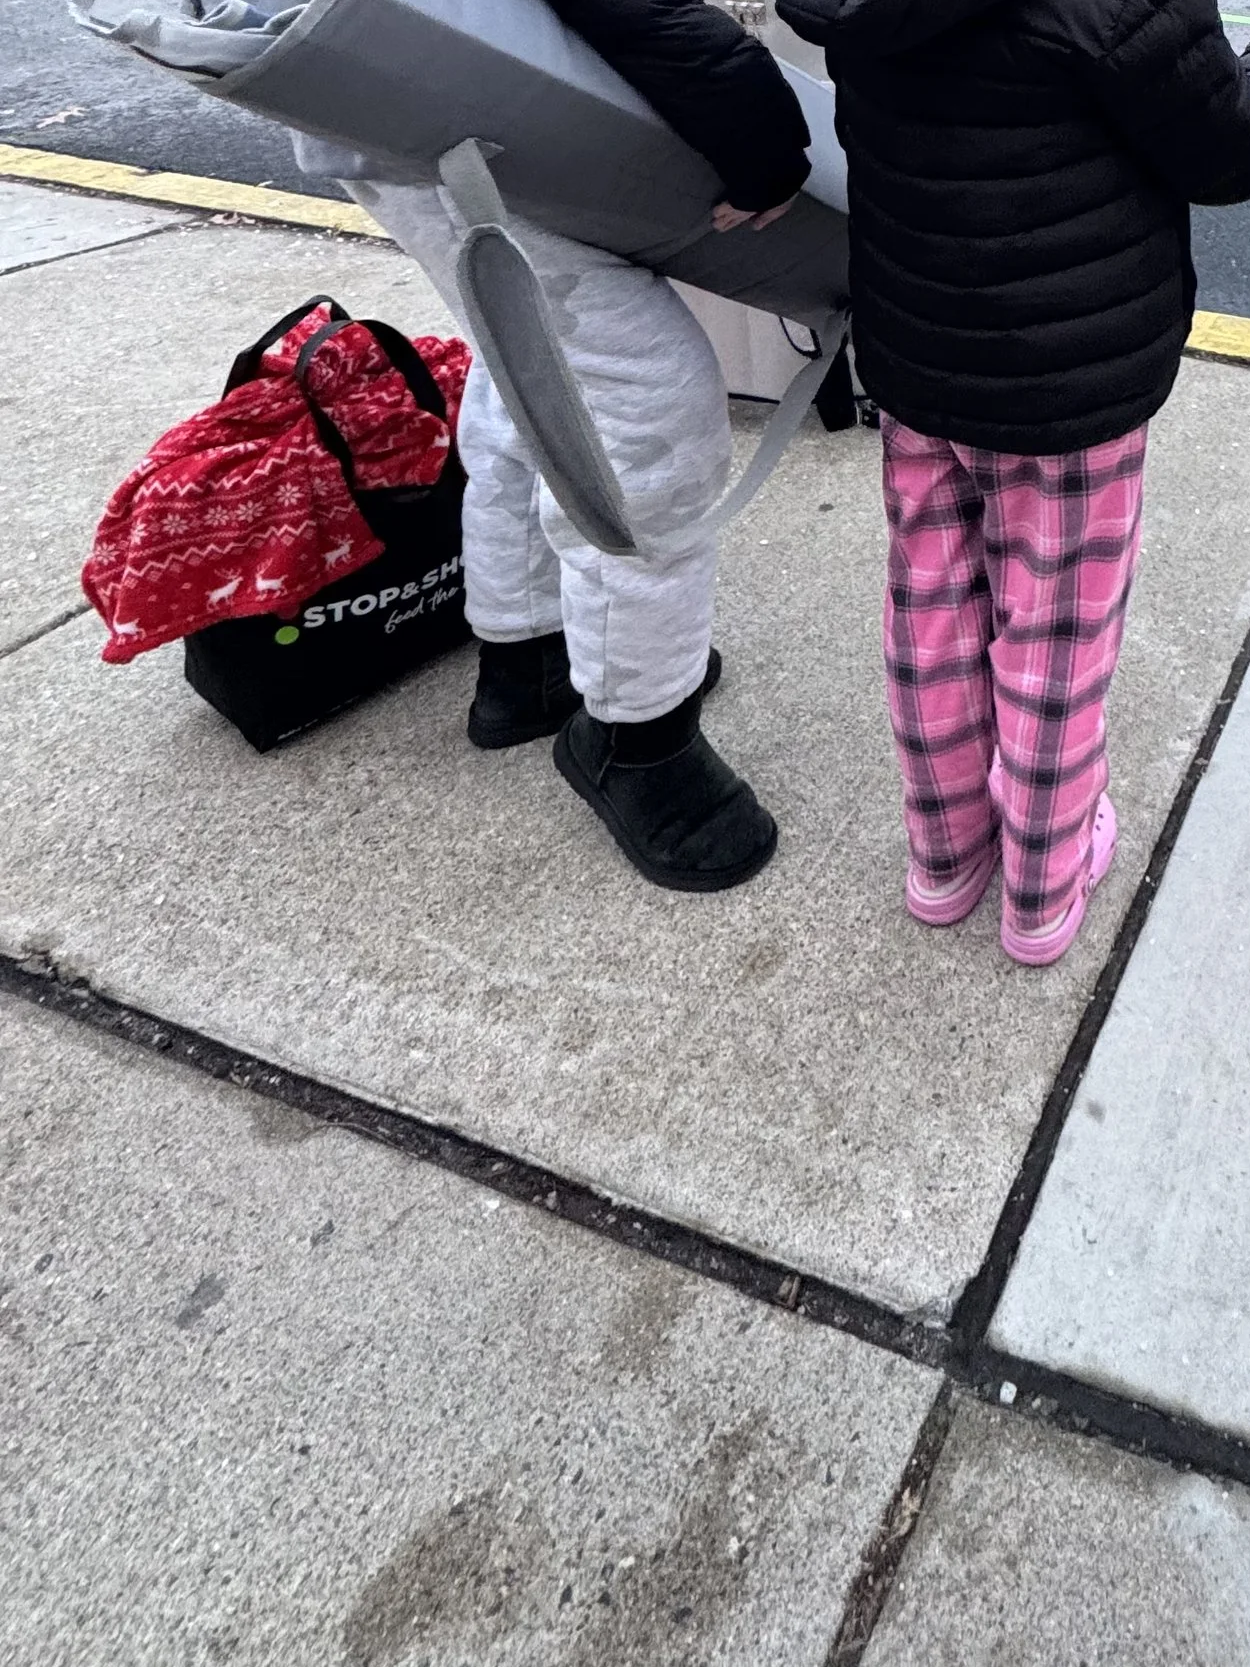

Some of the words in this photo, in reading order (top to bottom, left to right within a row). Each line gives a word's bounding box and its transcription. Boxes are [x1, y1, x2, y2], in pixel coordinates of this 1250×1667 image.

[303, 555, 464, 629] STOP&SH
[384, 597, 424, 634] feed
[427, 586, 459, 612] the
